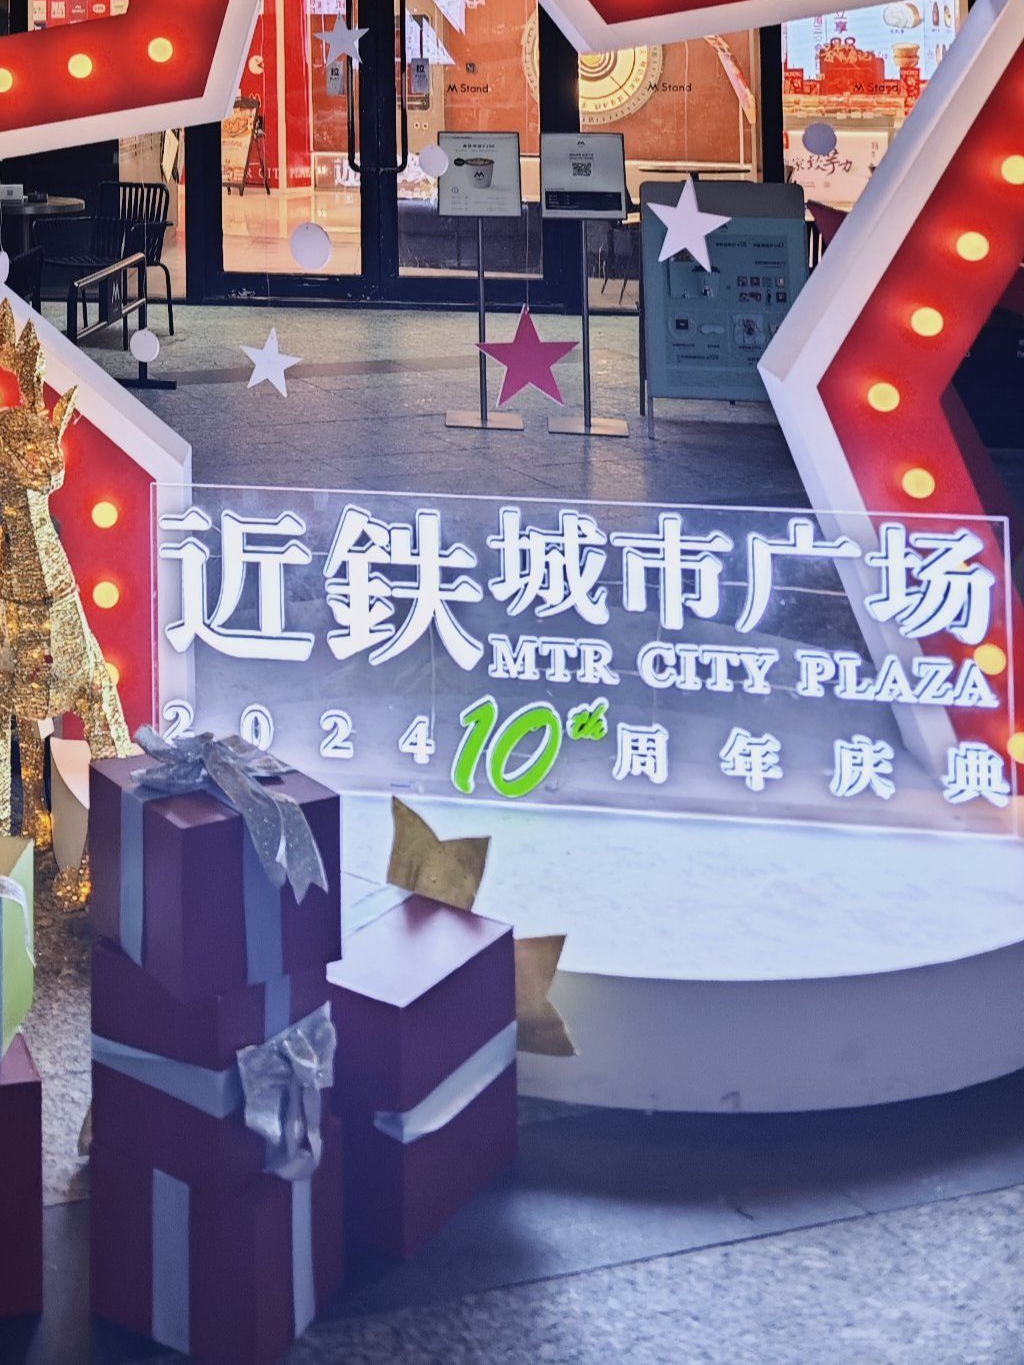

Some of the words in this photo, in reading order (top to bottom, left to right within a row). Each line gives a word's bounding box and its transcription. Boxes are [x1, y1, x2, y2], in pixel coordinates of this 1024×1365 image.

[447, 84, 458, 93] M
[460, 83, 489, 94] Stand
[647, 83, 660, 92] M
[662, 83, 692, 93] Stand
[869, 83, 899, 93] Stand
[488, 634, 620, 686] MTR
[637, 640, 779, 694] CITY
[795, 648, 1000, 708] PLAZA
[612, 723, 1012, 808] 周年庆典
